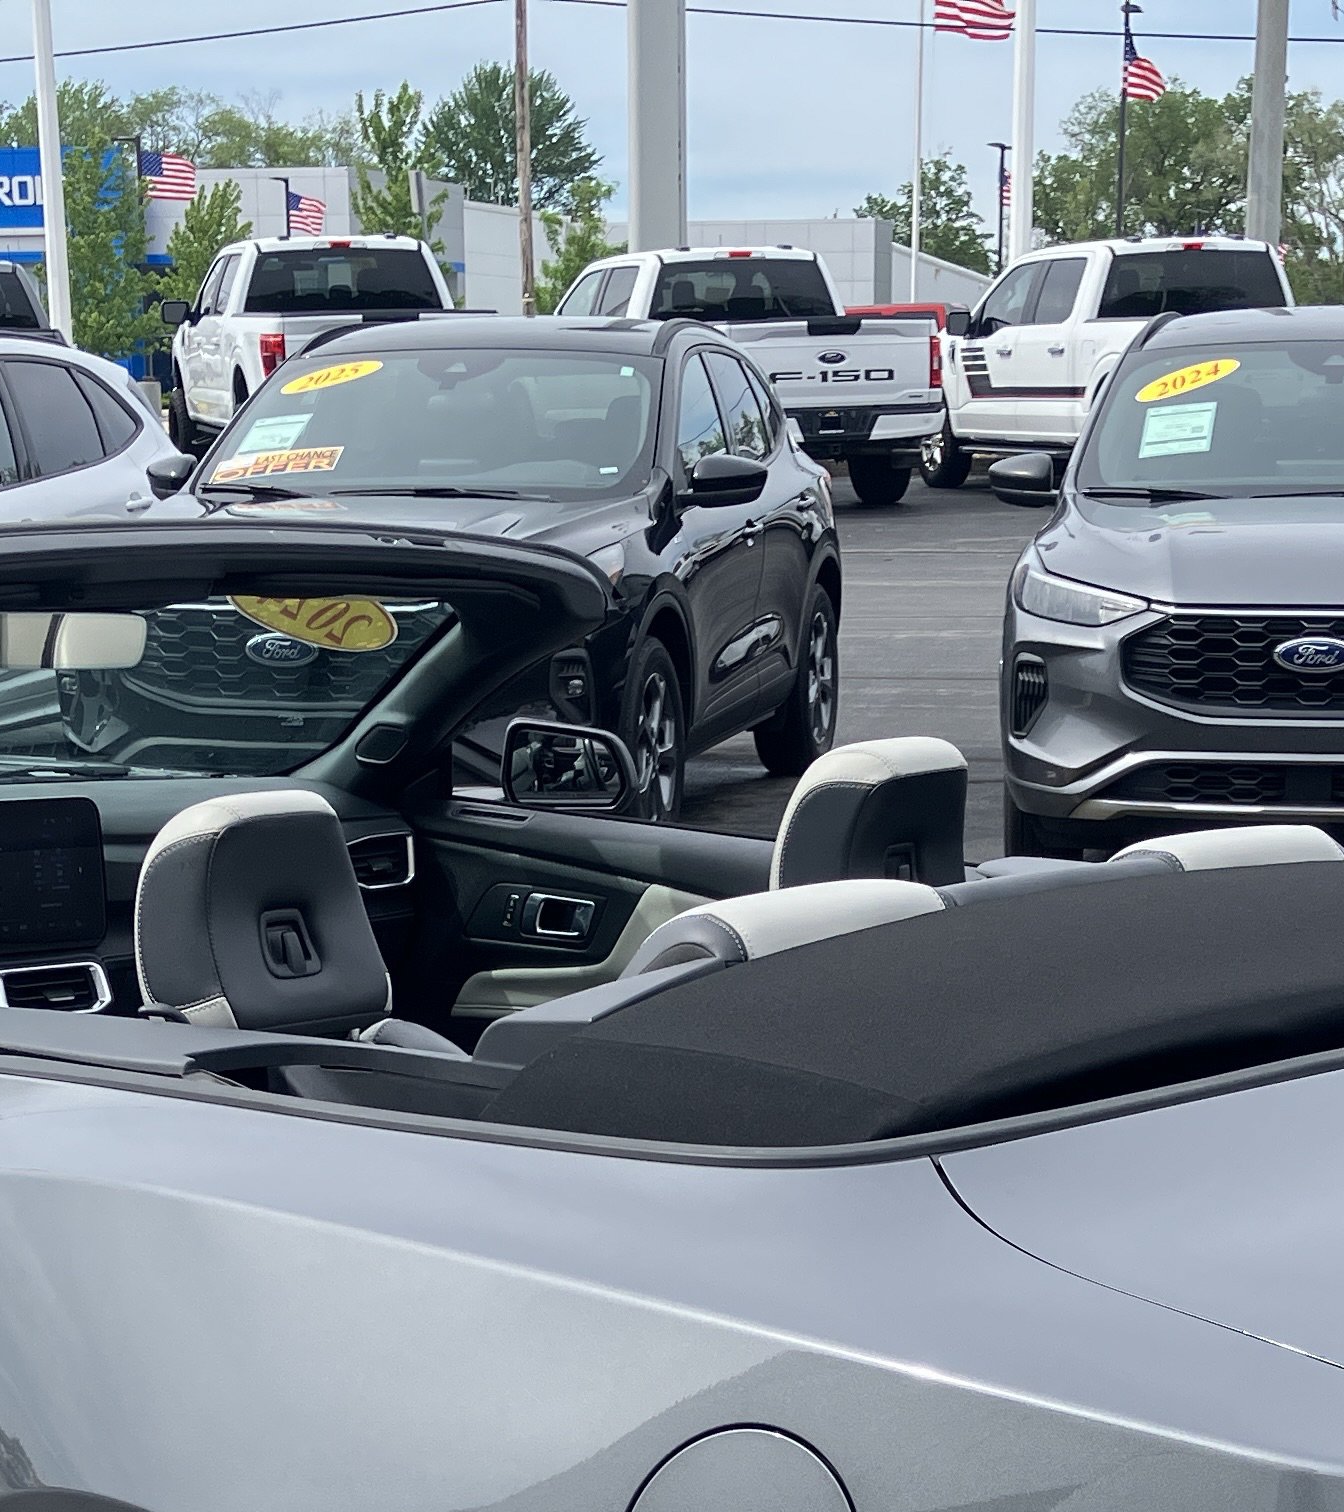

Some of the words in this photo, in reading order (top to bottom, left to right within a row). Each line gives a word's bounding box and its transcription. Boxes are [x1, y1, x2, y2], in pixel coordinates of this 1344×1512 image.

[297, 364, 364, 391] 2025
[769, 368, 895, 384] F-150
[1156, 362, 1221, 397] 2024
[256, 453, 284, 464] LAST
[286, 449, 339, 461] CHANCE
[214, 459, 331, 481] OFFER
[262, 639, 302, 659] Ford
[1293, 644, 1340, 665] Ford
